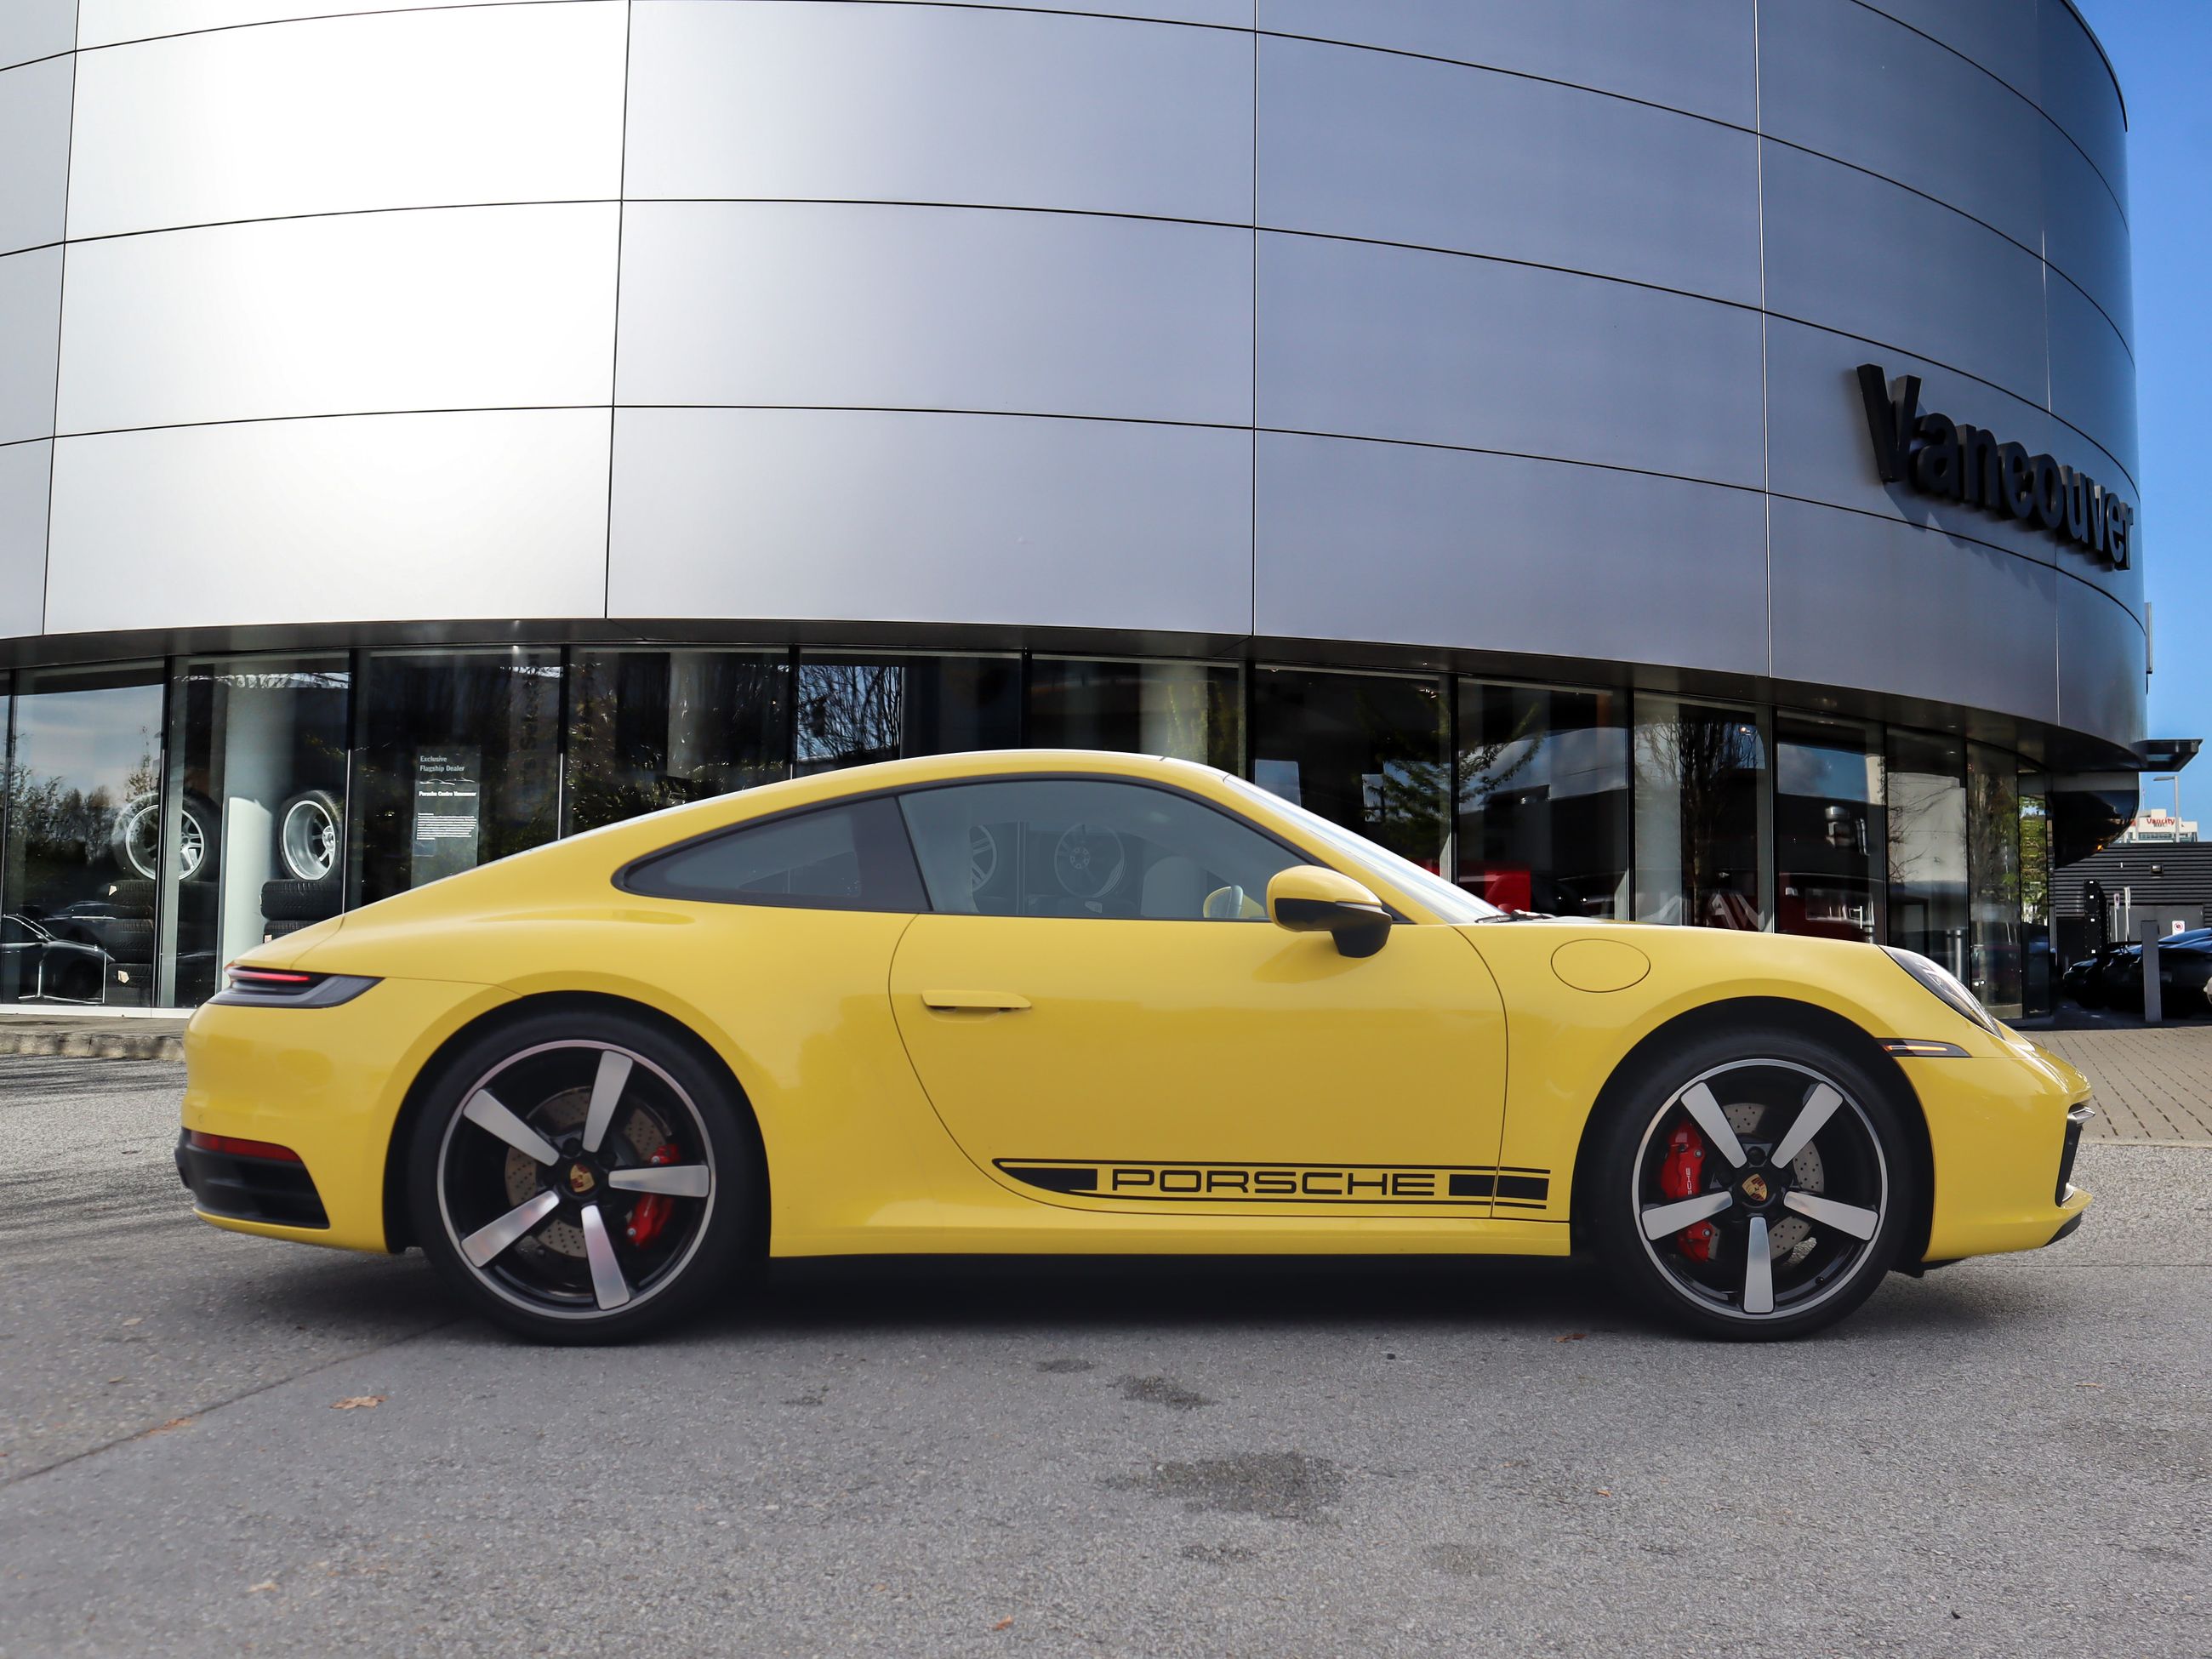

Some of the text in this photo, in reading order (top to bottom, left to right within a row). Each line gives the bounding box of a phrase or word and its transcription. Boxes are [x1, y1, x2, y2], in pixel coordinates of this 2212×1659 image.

[1856, 363, 2134, 570] Vancouver
[2146, 817, 2175, 825] Vancity
[1112, 1169, 1435, 1196] PORSCHE
